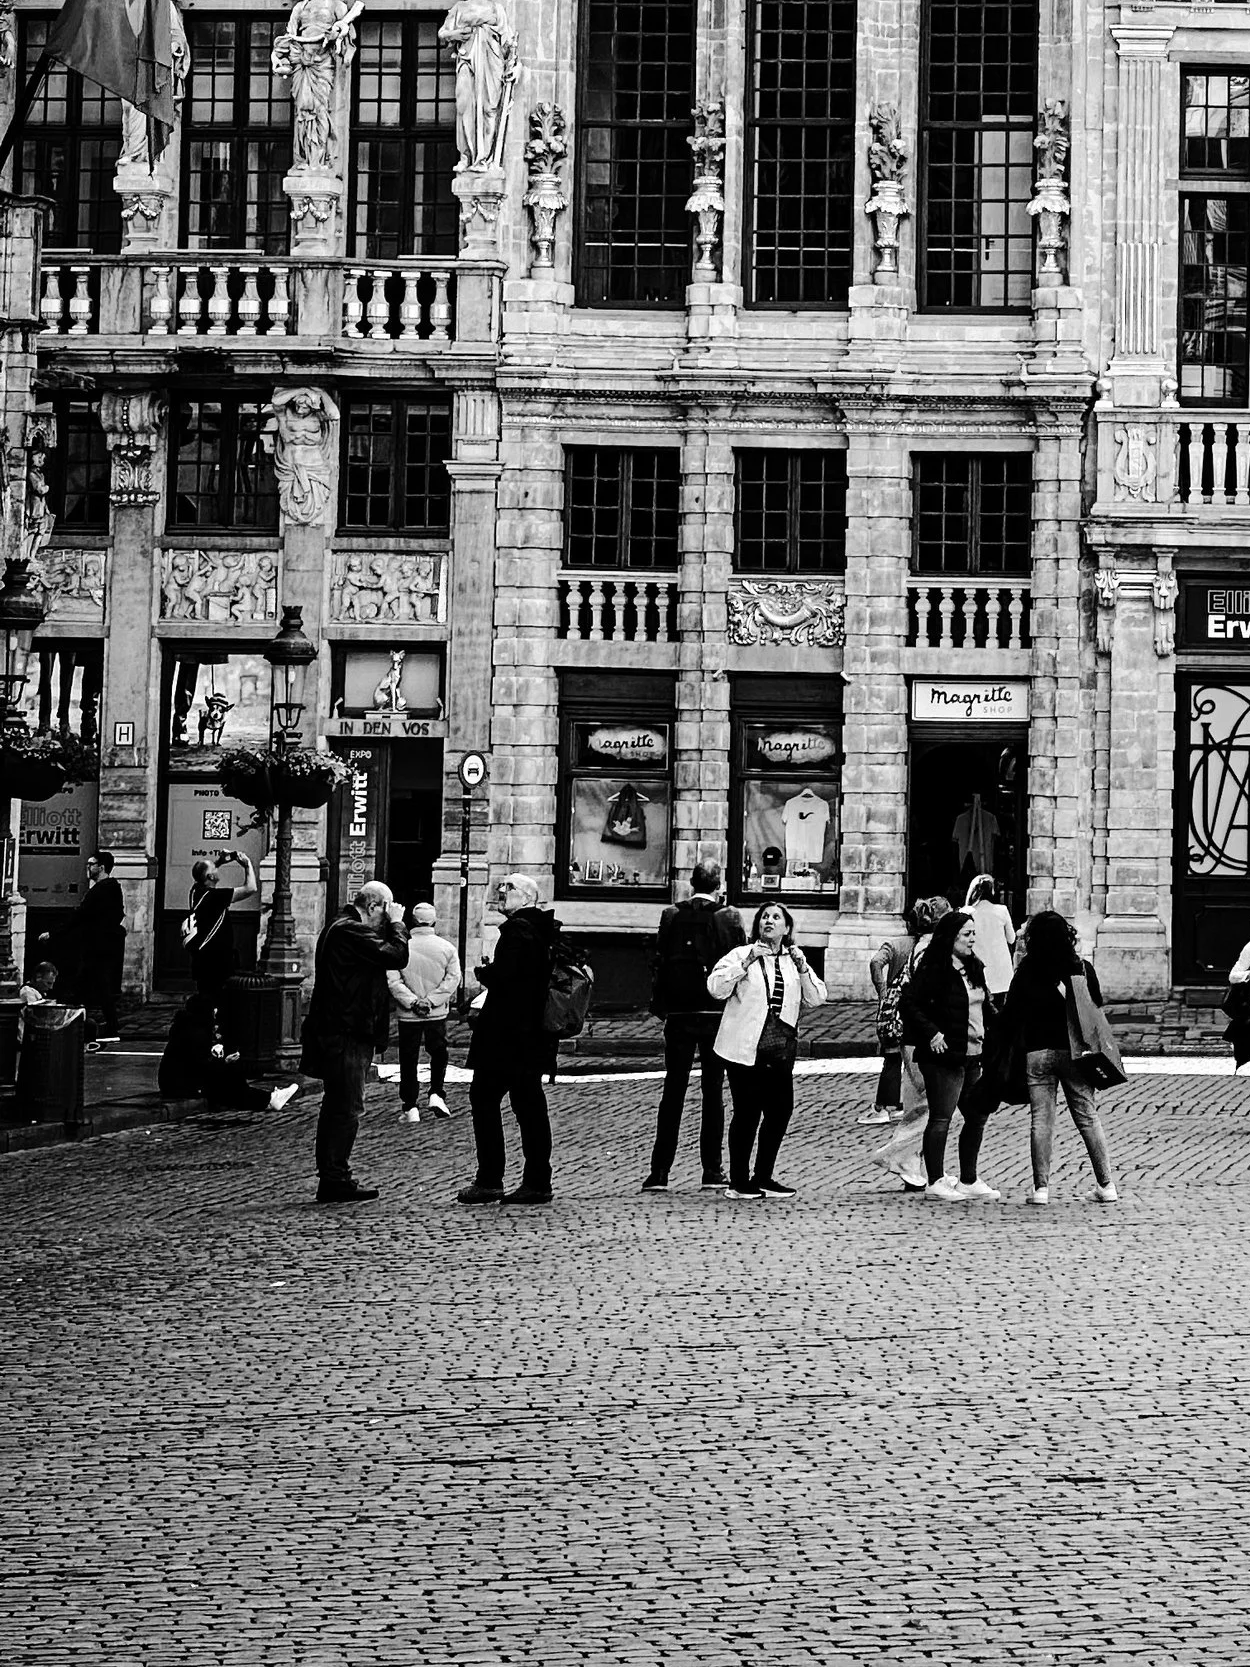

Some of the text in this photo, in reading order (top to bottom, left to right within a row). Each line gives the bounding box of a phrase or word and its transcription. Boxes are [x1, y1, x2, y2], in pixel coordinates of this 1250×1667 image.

[983, 706, 1012, 714] SHOP
[119, 726, 130, 742] H
[340, 722, 430, 735] IN DEN VOS
[350, 750, 372, 759] EXPO
[349, 772, 368, 836] Erwitt
